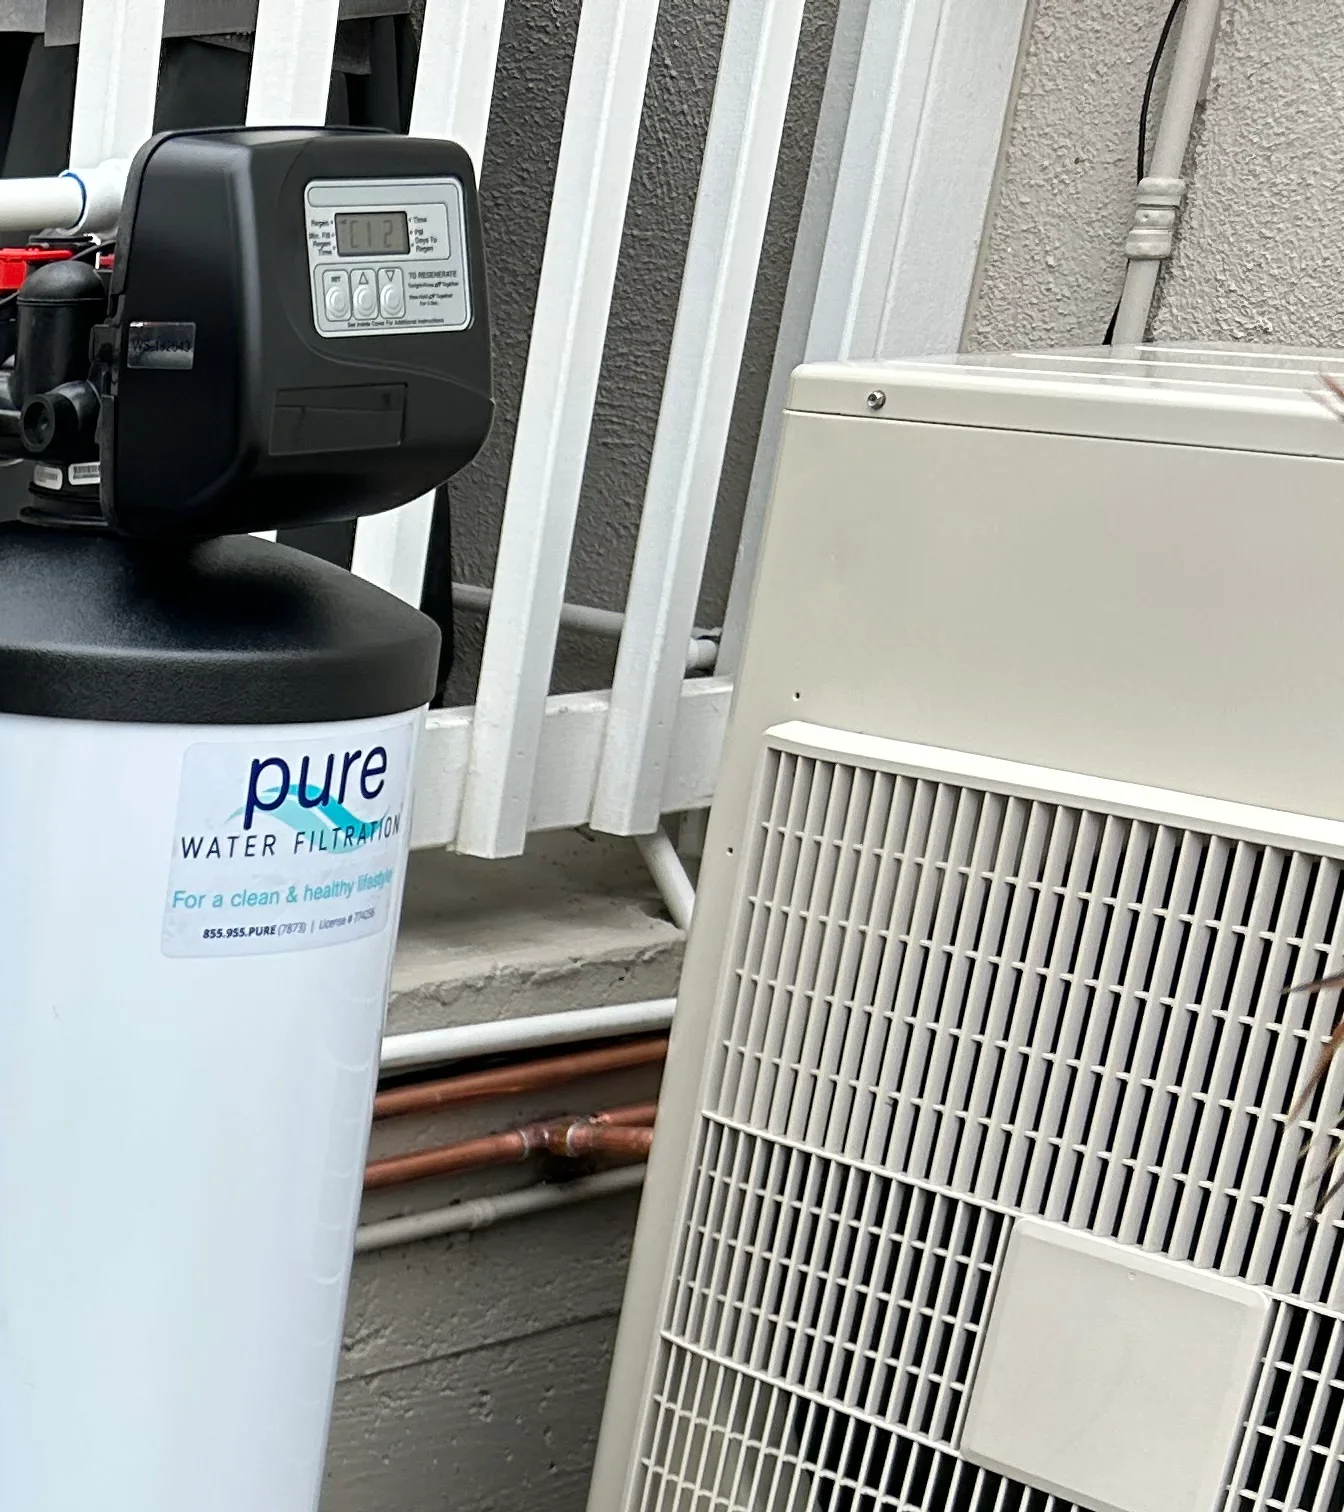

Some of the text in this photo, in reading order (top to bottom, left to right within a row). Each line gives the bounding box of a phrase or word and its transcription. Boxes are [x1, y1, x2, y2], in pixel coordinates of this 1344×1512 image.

[418, 270, 456, 278] REGENERATE
[243, 746, 387, 830] pure
[181, 813, 401, 859] WATER FILTRATION
[172, 868, 394, 909] For a clean & healthy lifestyle
[203, 925, 276, 940] 855.955.PURE
[277, 922, 307, 937] (7873)
